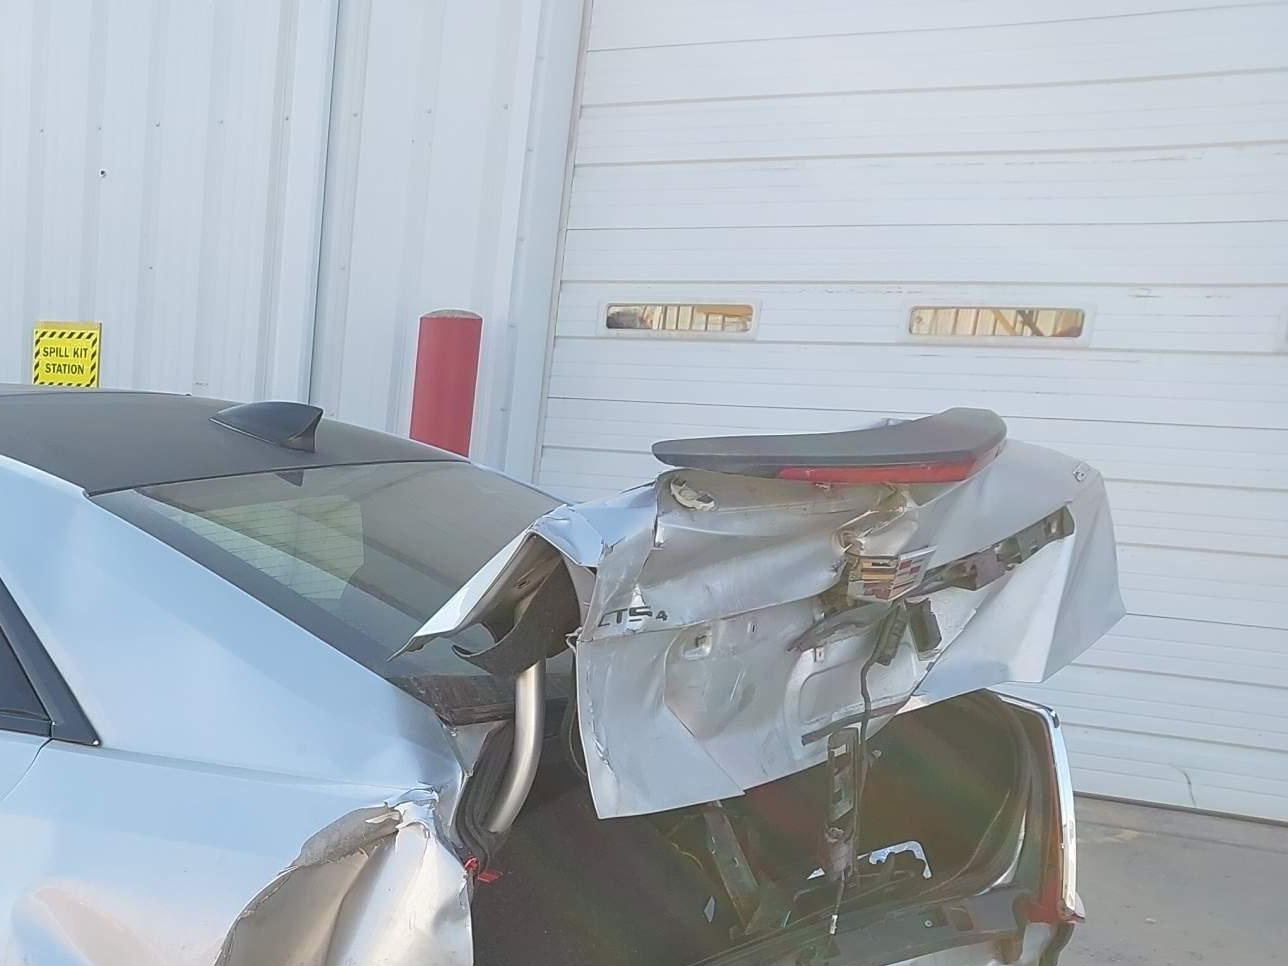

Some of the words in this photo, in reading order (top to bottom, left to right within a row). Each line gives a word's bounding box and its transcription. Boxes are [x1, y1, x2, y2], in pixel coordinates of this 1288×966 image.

[42, 347, 69, 358] SPILL
[73, 347, 88, 359] KIT
[45, 363, 85, 375] STATION
[598, 606, 653, 627] CTS
